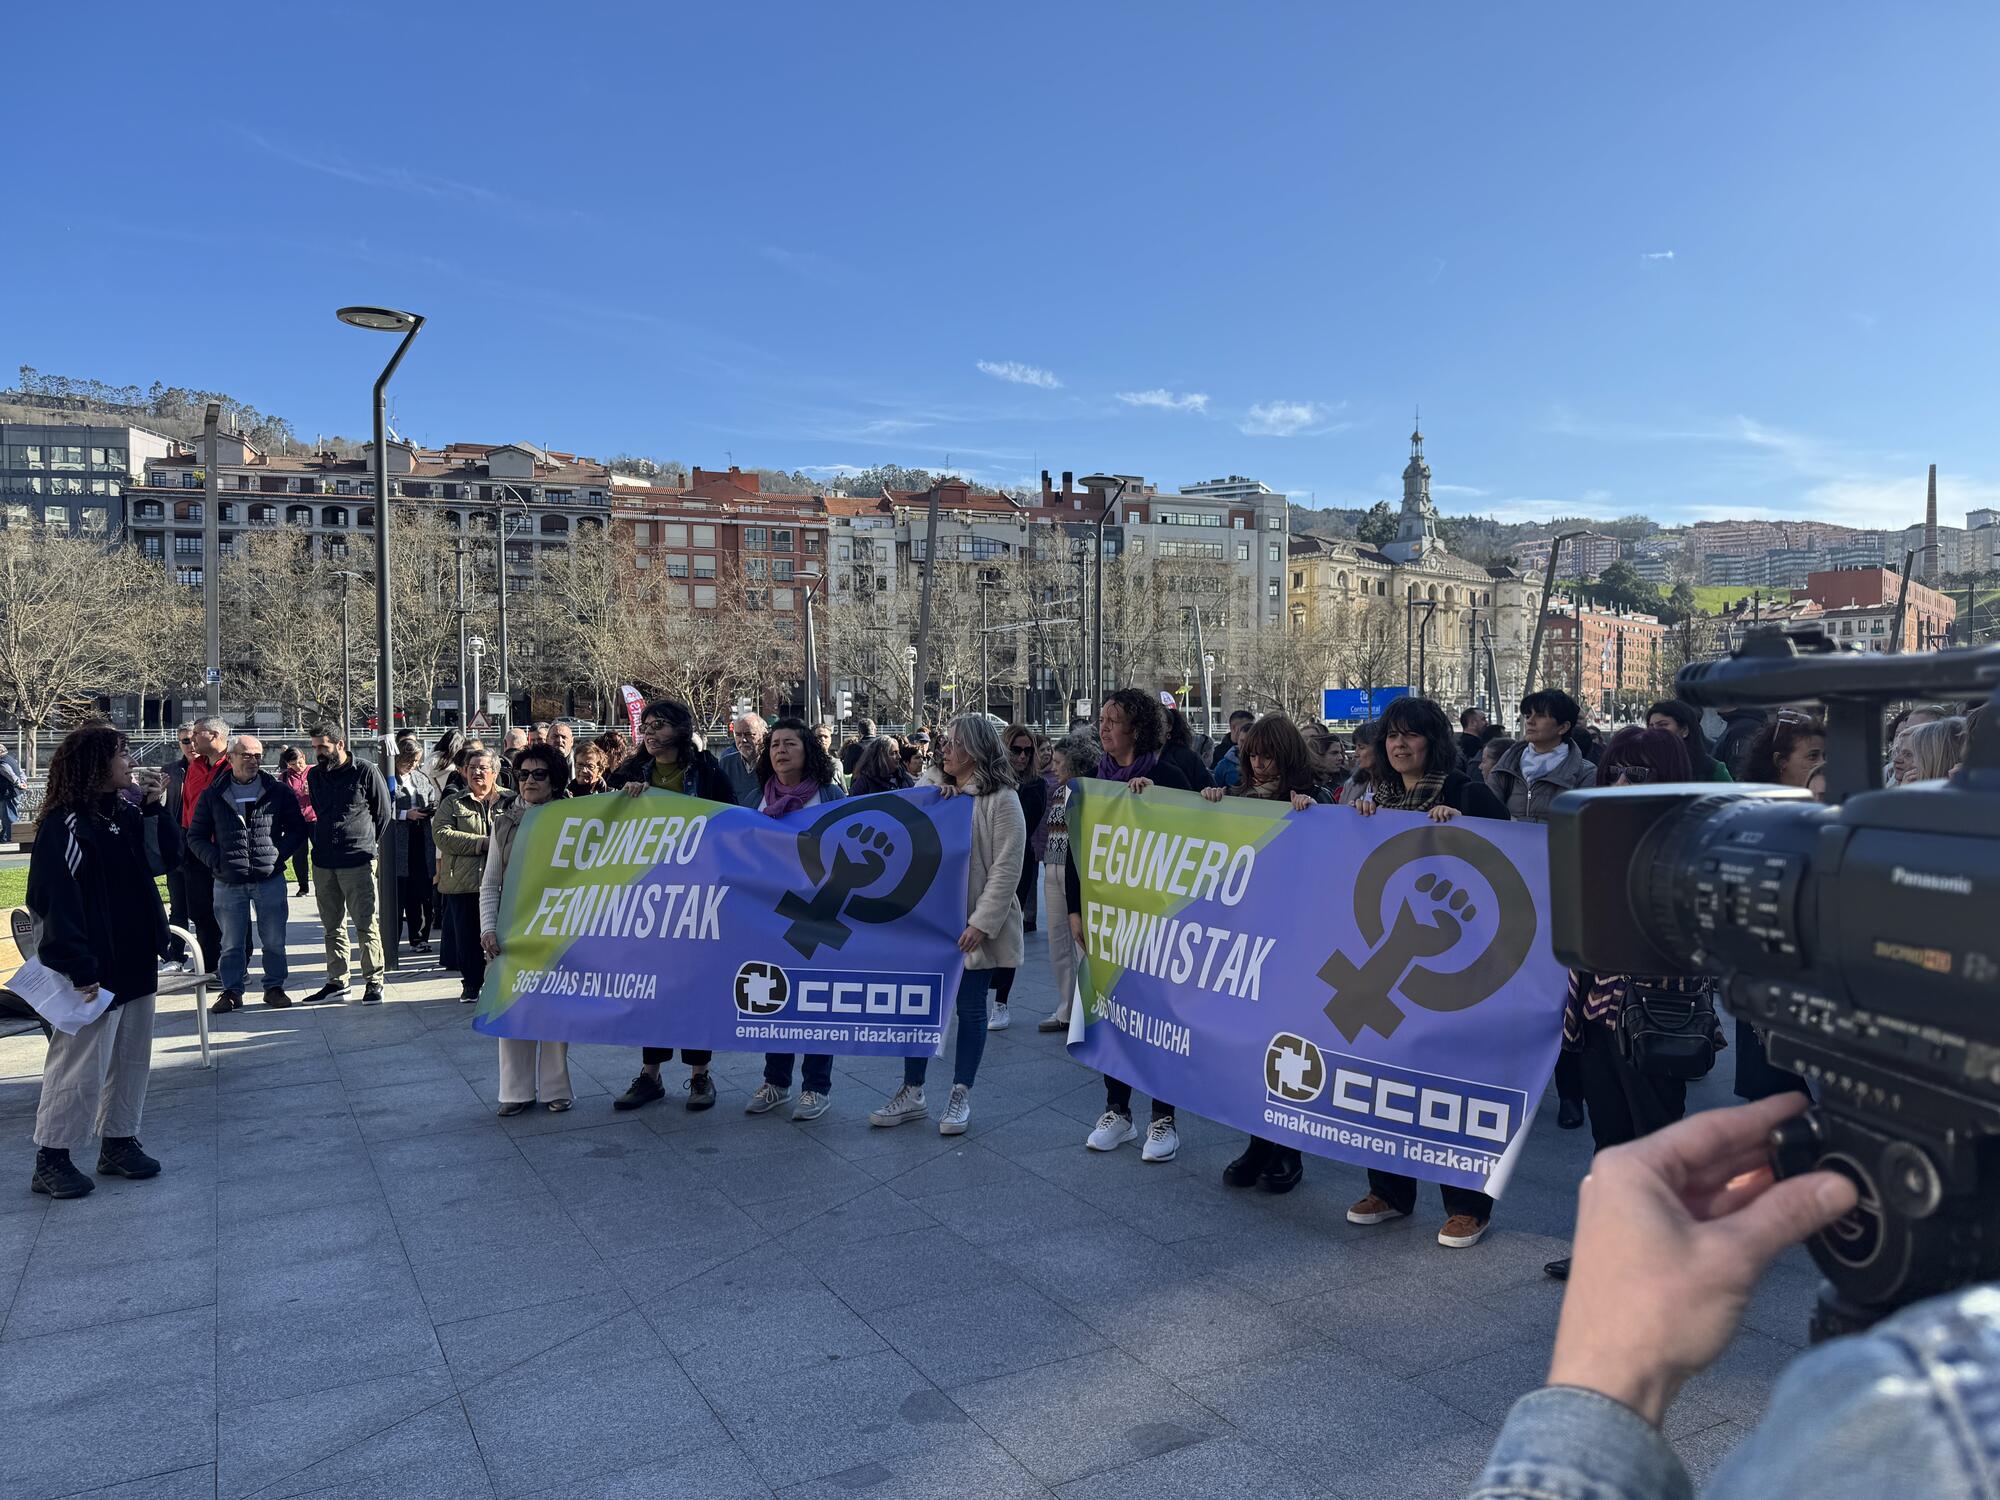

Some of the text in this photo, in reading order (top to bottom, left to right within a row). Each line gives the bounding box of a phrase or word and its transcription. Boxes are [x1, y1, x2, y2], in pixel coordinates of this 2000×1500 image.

[551, 815, 708, 871] EGUNERO
[1088, 824, 1256, 906] EGUNERO
[1891, 866, 1972, 894] Panasonic
[524, 884, 730, 940] FEMINISTAK
[1087, 901, 1277, 1001] FEMINISTAK
[511, 964, 657, 1000] 365 DÍAS EN LUCHA
[797, 981, 931, 1015] CCOO
[735, 1023, 941, 1044] emakumearen idazkaritza
[1090, 989, 1190, 1057] 365 DÍAS EN LUCHA
[1263, 1108, 1397, 1156] emakumearen
[1332, 1068, 1510, 1143] CCOO
